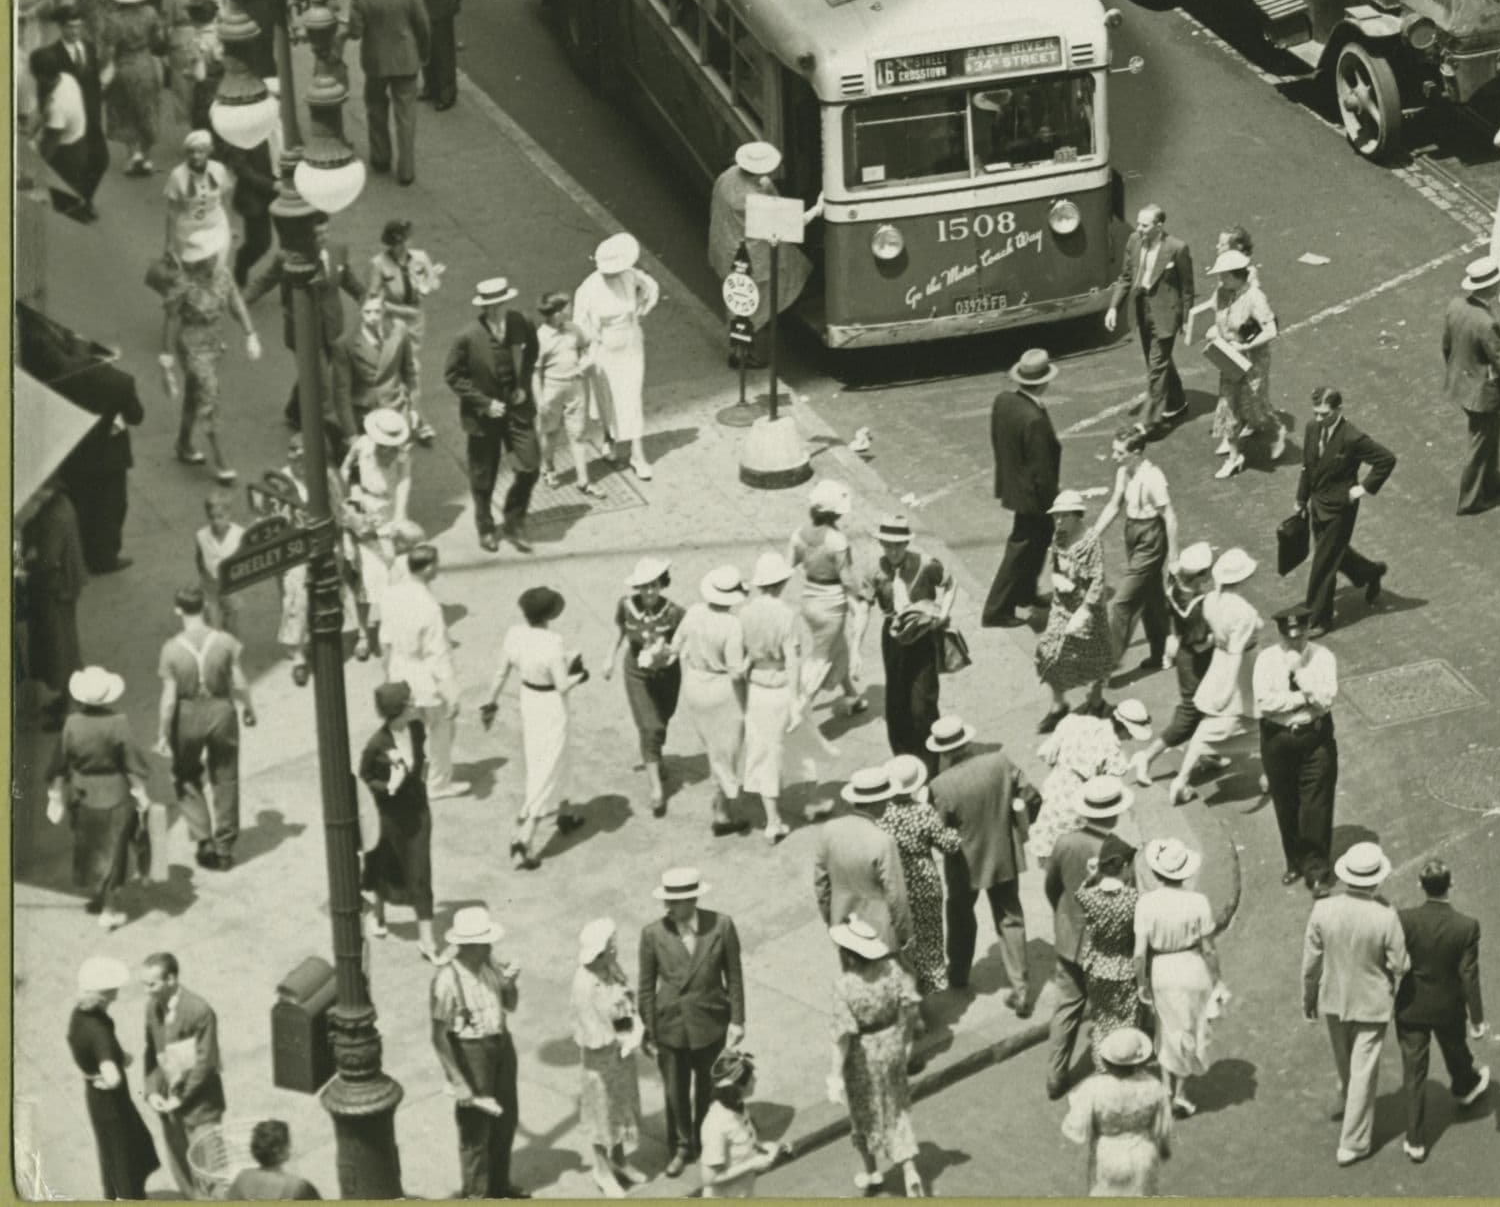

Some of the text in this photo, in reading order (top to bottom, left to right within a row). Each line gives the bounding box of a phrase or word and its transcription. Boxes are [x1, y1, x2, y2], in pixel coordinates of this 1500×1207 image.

[967, 38, 1057, 60] EAST RIVER
[1002, 51, 1057, 68] STREET
[877, 61, 895, 86] 16
[898, 66, 947, 83] CROSSTOWN
[937, 211, 1016, 242] 1508
[905, 229, 1043, 310] Go the Motor Coach Way
[728, 277, 755, 294] BUS
[727, 293, 756, 312] STOP
[230, 539, 304, 581] GREELEY SQ
